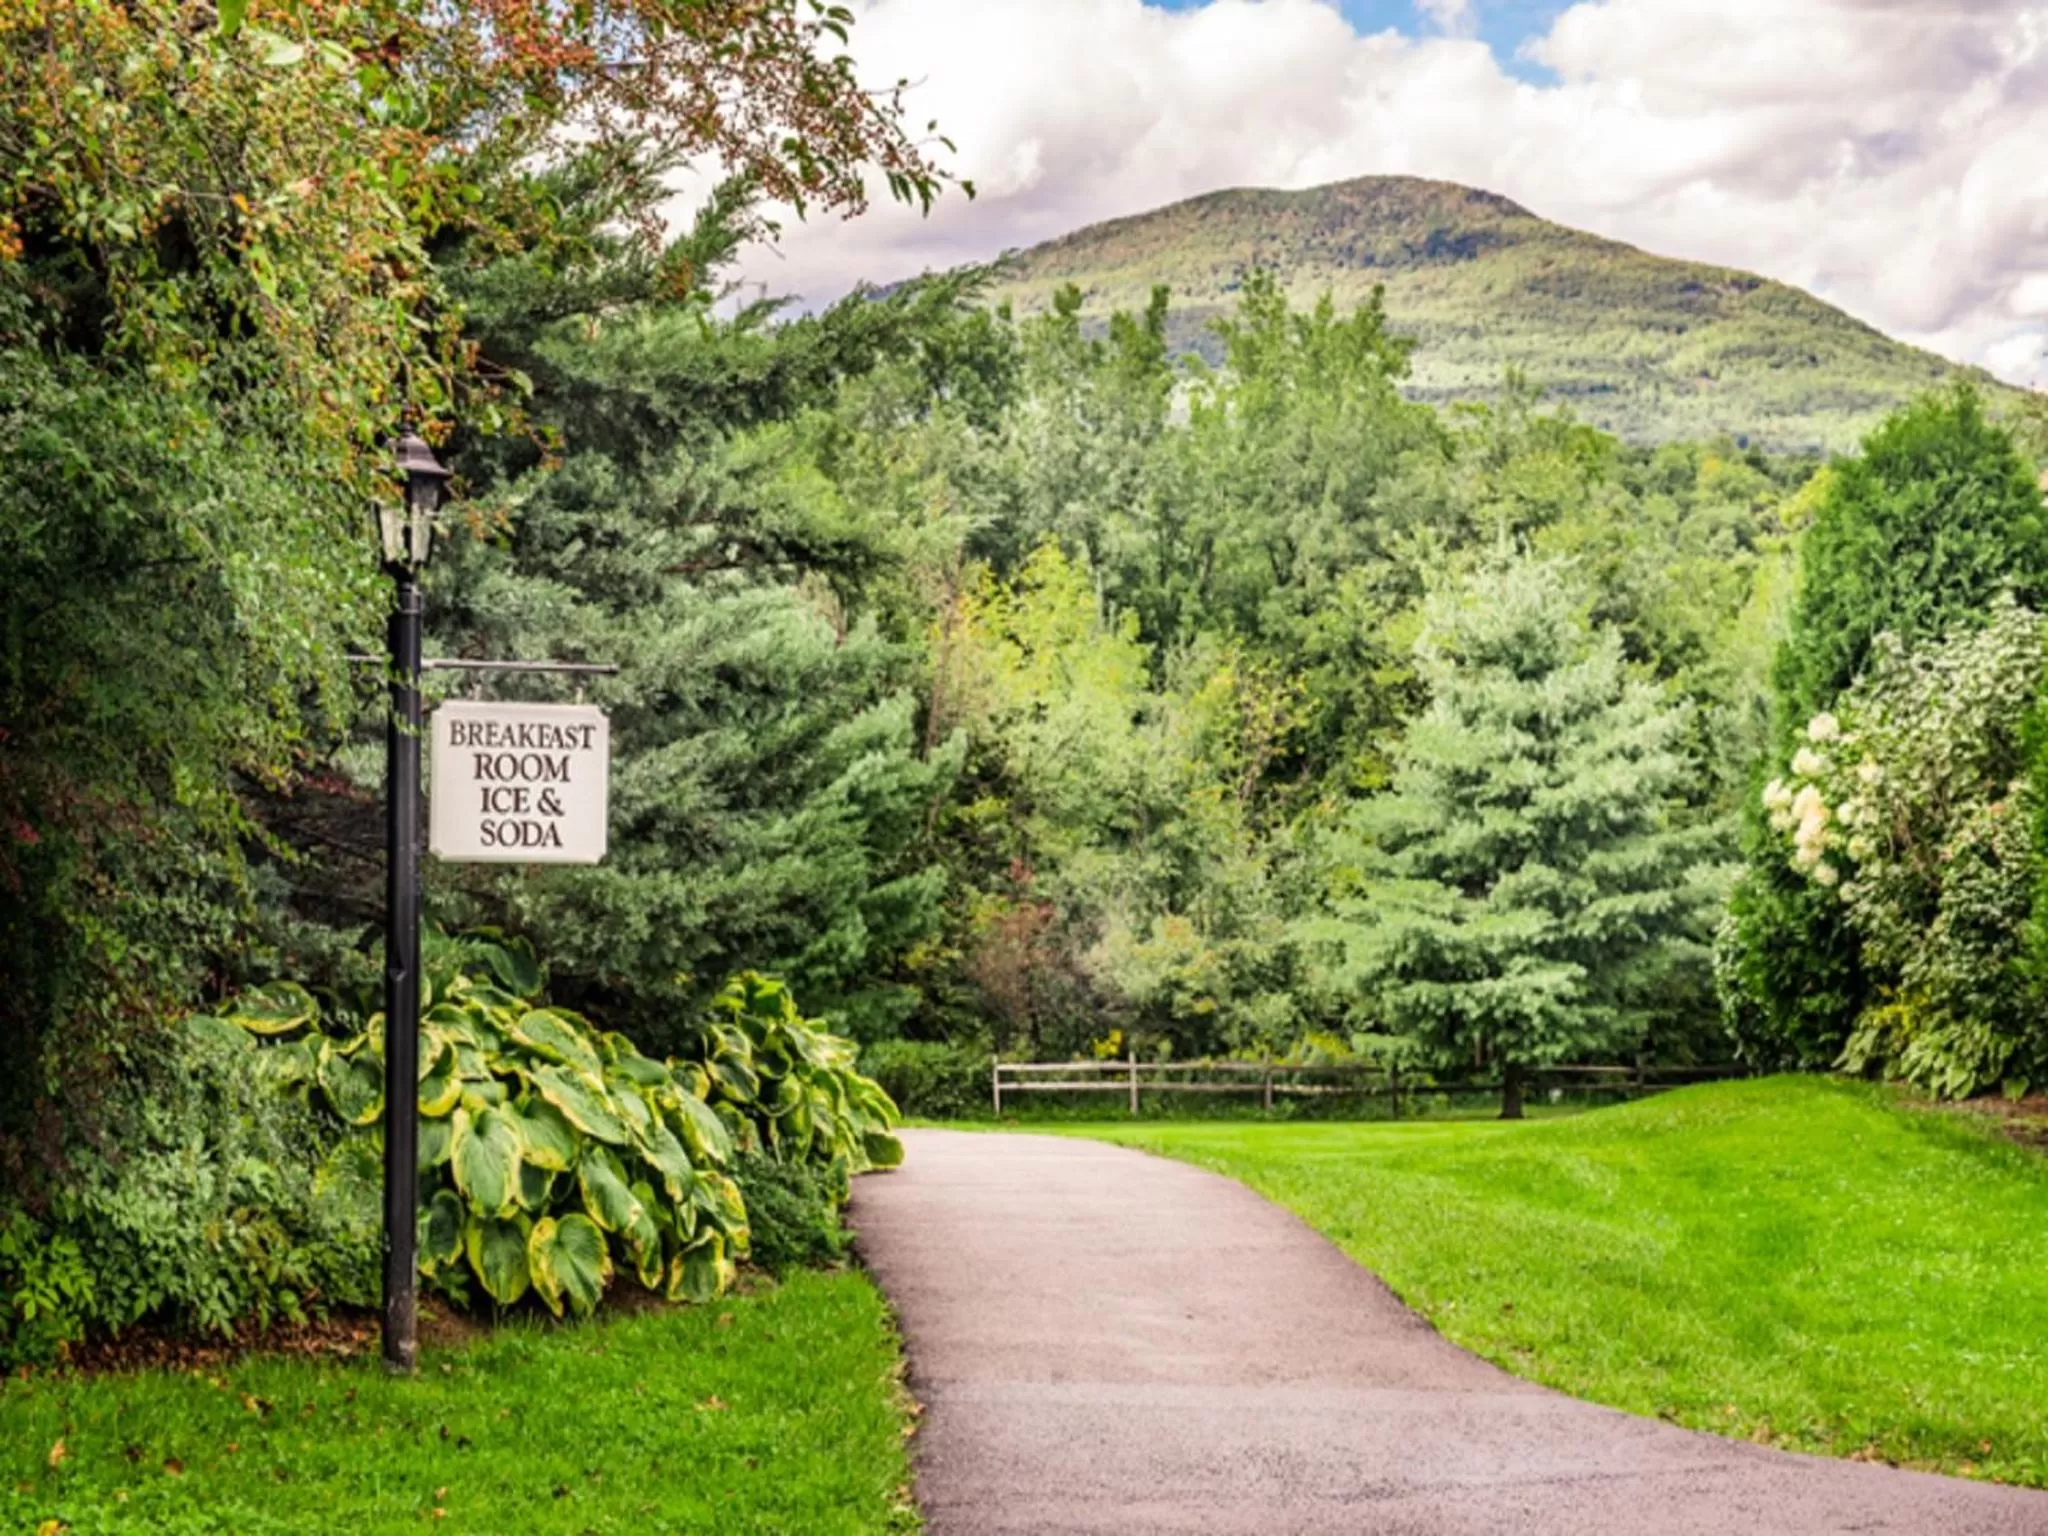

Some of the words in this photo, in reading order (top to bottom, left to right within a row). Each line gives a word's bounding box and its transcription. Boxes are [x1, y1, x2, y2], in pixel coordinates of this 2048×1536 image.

[449, 720, 596, 749] BREAKFAST
[473, 753, 571, 782] ROOM
[480, 787, 530, 814] ICE
[537, 787, 564, 816] &
[480, 819, 563, 847] SODA
